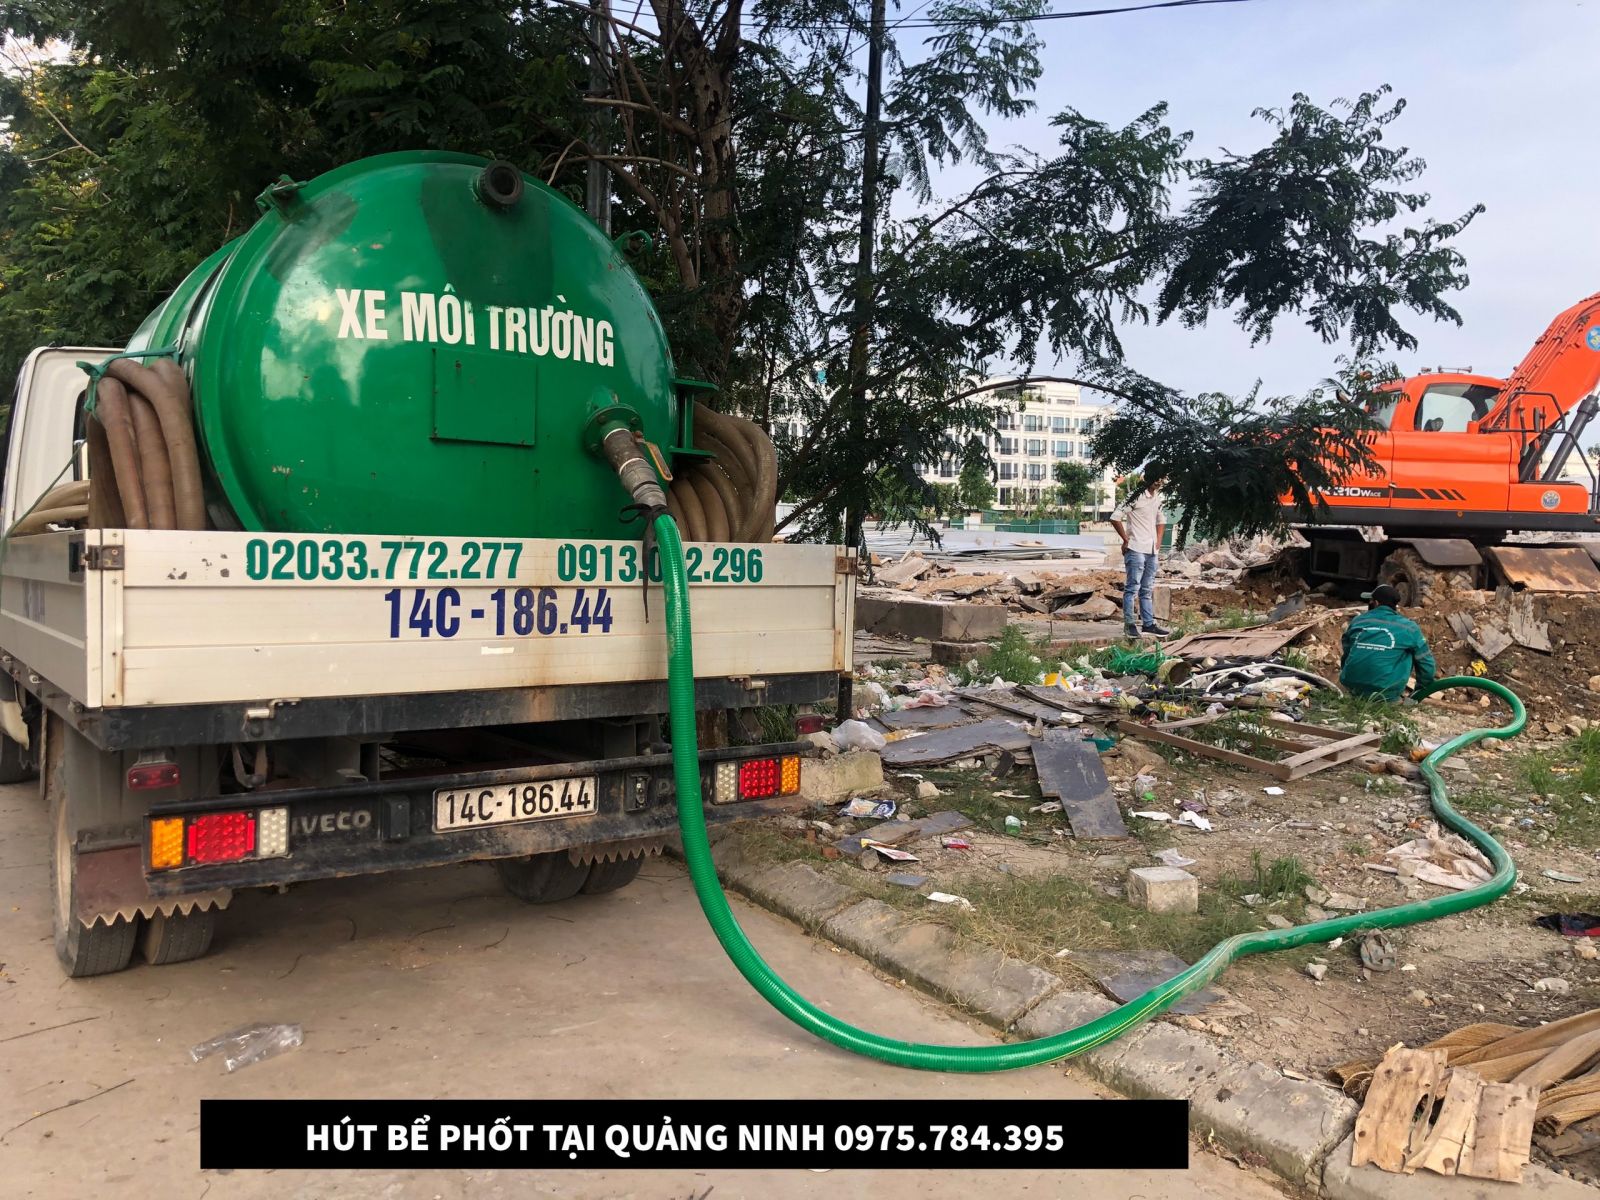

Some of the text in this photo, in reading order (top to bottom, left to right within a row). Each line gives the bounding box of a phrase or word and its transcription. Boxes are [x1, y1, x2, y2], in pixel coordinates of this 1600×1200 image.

[335, 283, 614, 368] XE MÔI TRƯỜNG
[246, 539, 523, 580] 02033.772.277
[557, 543, 763, 583] 0913.02.296
[291, 809, 372, 834] IVECO
[446, 780, 591, 825] 14C-186.44
